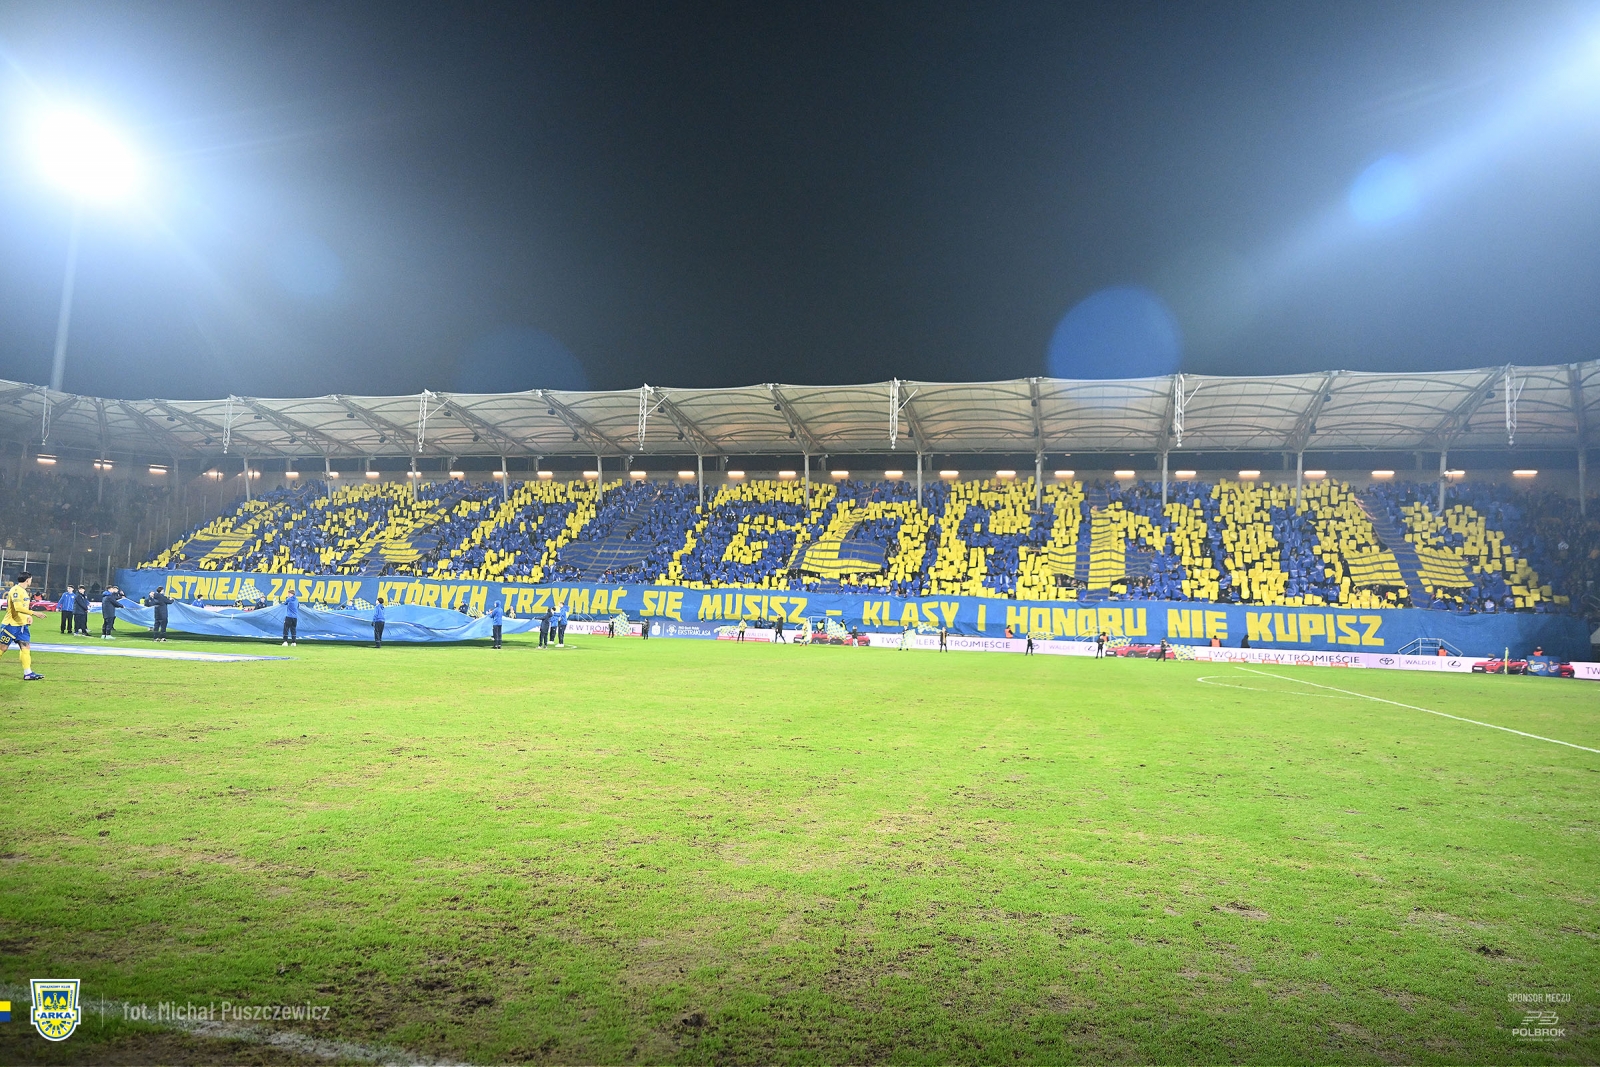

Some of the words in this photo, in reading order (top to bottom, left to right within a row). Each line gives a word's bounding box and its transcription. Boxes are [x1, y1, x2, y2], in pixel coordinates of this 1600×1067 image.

[266, 578, 362, 604] ZASADY
[377, 579, 488, 613] KTÓRYCH
[501, 586, 627, 616] TRZYMAĆ
[640, 590, 684, 623] SIĘ
[698, 594, 809, 629] MUSISZ
[862, 601, 959, 629] KLASY
[977, 604, 987, 631] I
[1005, 605, 1147, 639] HONORU
[1167, 609, 1228, 641] NIE
[1246, 611, 1385, 647] KUPISZ
[1240, 652, 1271, 661] DILER
[1273, 652, 1286, 661] W
[1288, 652, 1361, 664] TRÓJMIEŚCIE
